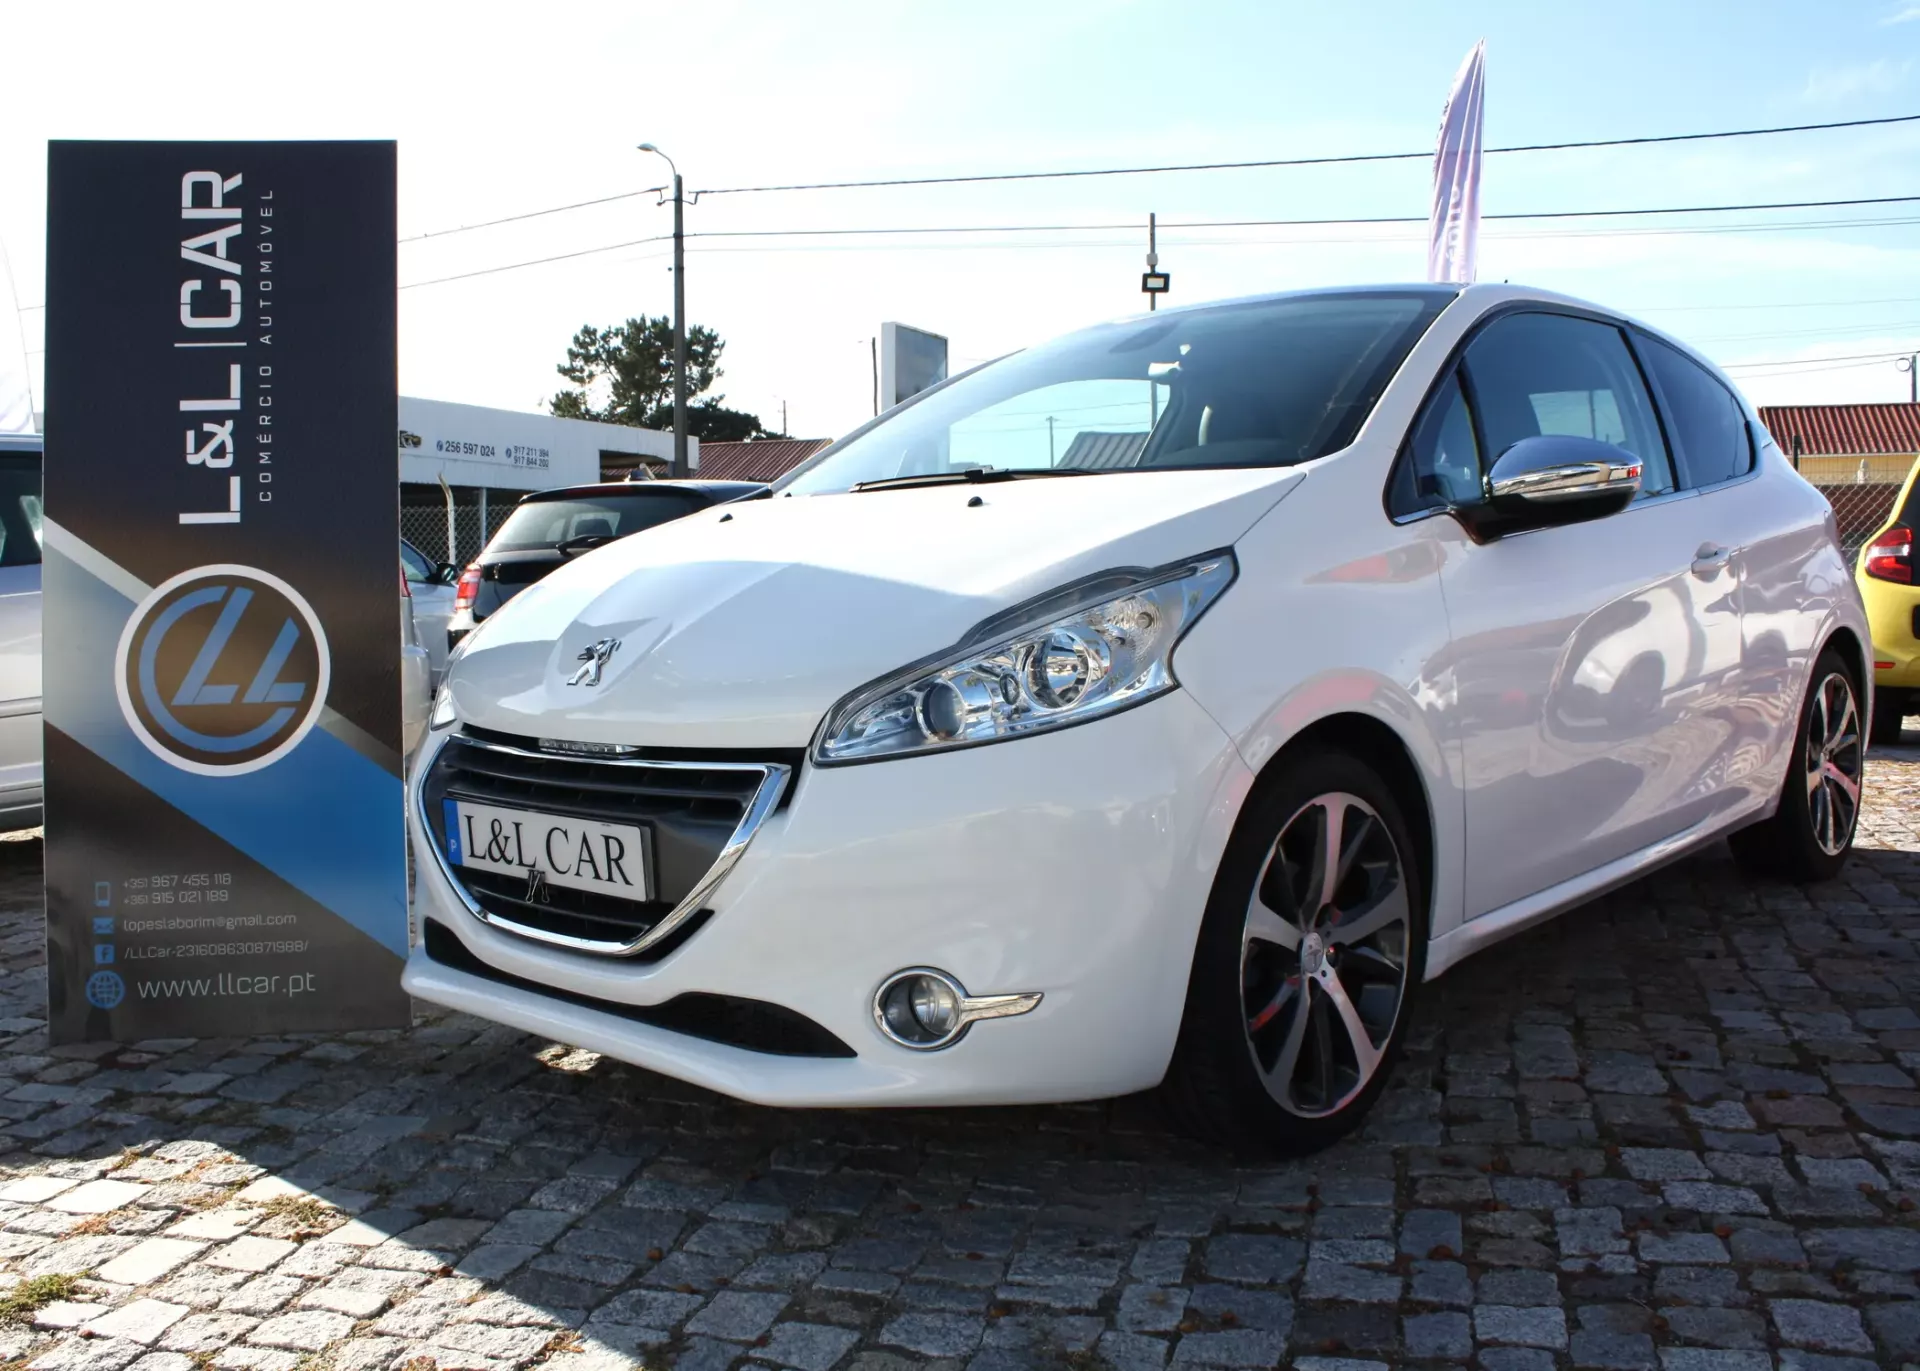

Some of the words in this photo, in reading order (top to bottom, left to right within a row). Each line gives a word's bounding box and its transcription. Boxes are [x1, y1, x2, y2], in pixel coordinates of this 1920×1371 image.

[180, 170, 243, 329] CAR
[256, 189, 274, 345] AUTOMÓVEL
[256, 365, 273, 502] COMÉRCIO
[445, 440, 461, 454] 256
[463, 442, 479, 456] 597
[480, 445, 495, 457] 024
[151, 875, 179, 888] 967
[464, 815, 537, 869] L&L
[545, 826, 634, 887] CAR
[137, 971, 316, 998] www.llcar.pt
